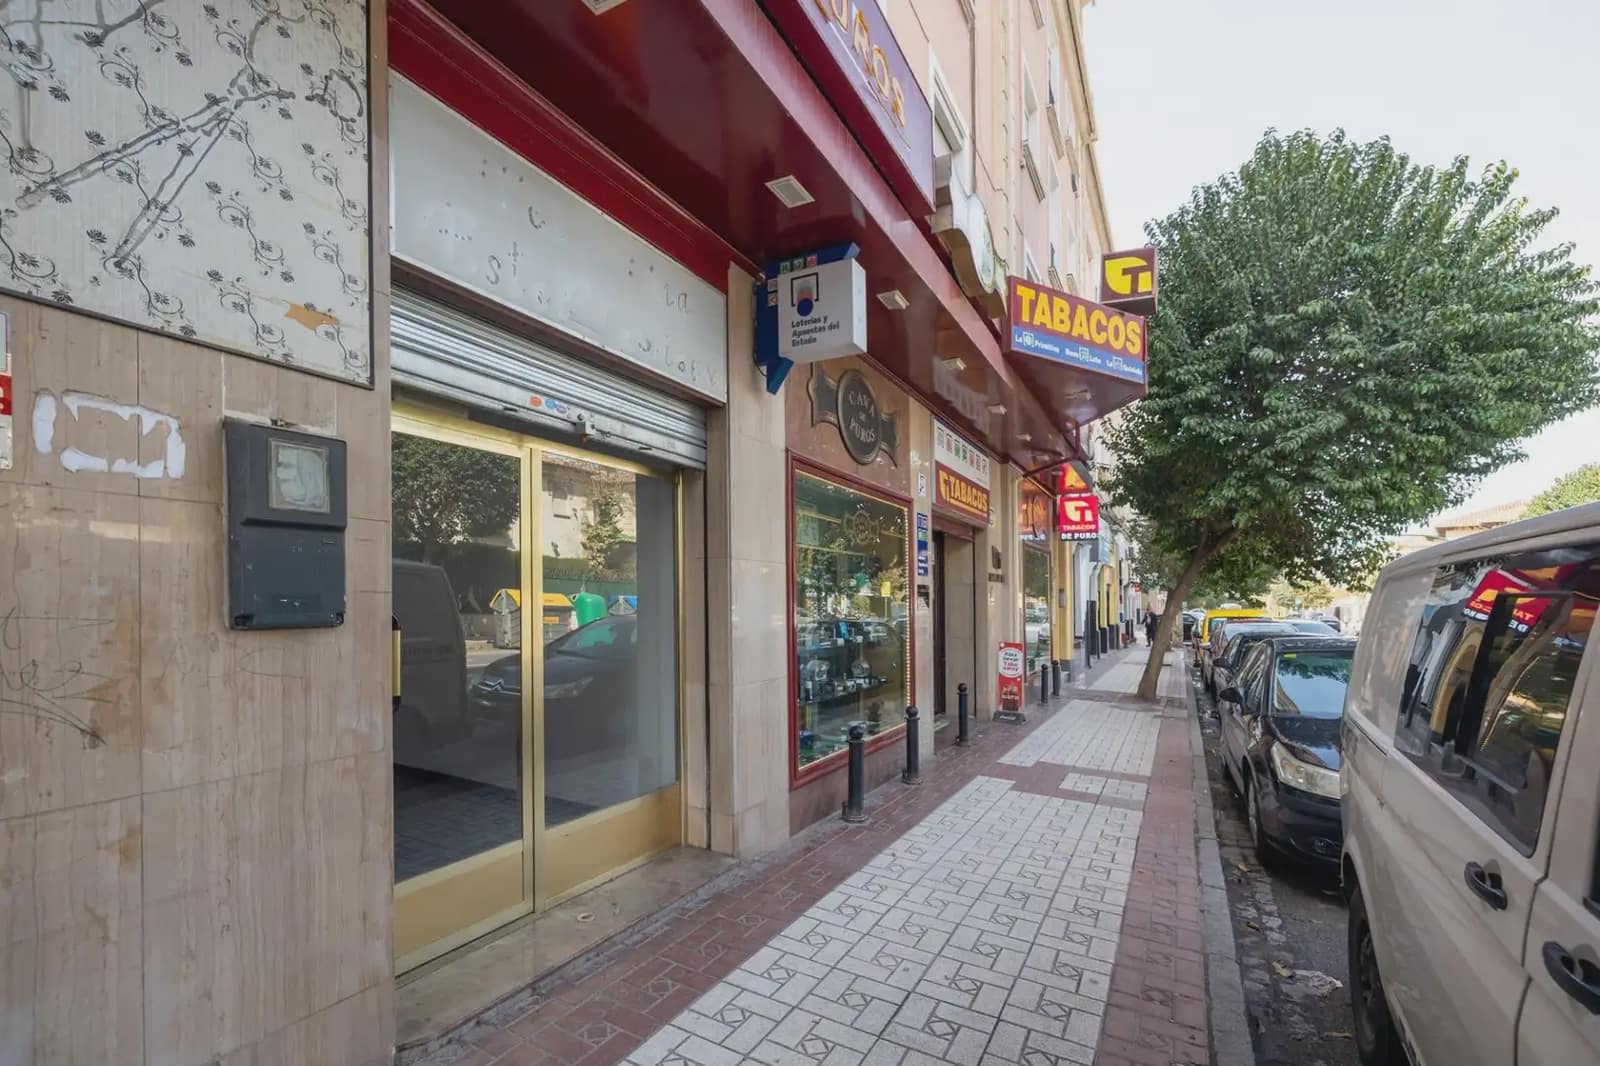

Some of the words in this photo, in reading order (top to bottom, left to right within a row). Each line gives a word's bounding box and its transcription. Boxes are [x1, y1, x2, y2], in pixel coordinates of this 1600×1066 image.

[823, 315, 828, 324] y
[828, 320, 840, 331] del
[1016, 284, 1141, 354] TABACOS
[792, 336, 816, 347] Estado
[849, 391, 875, 417] CAVA
[849, 416, 875, 443] PUROS
[949, 475, 988, 513] TABACOS
[1074, 532, 1097, 540] PURO
